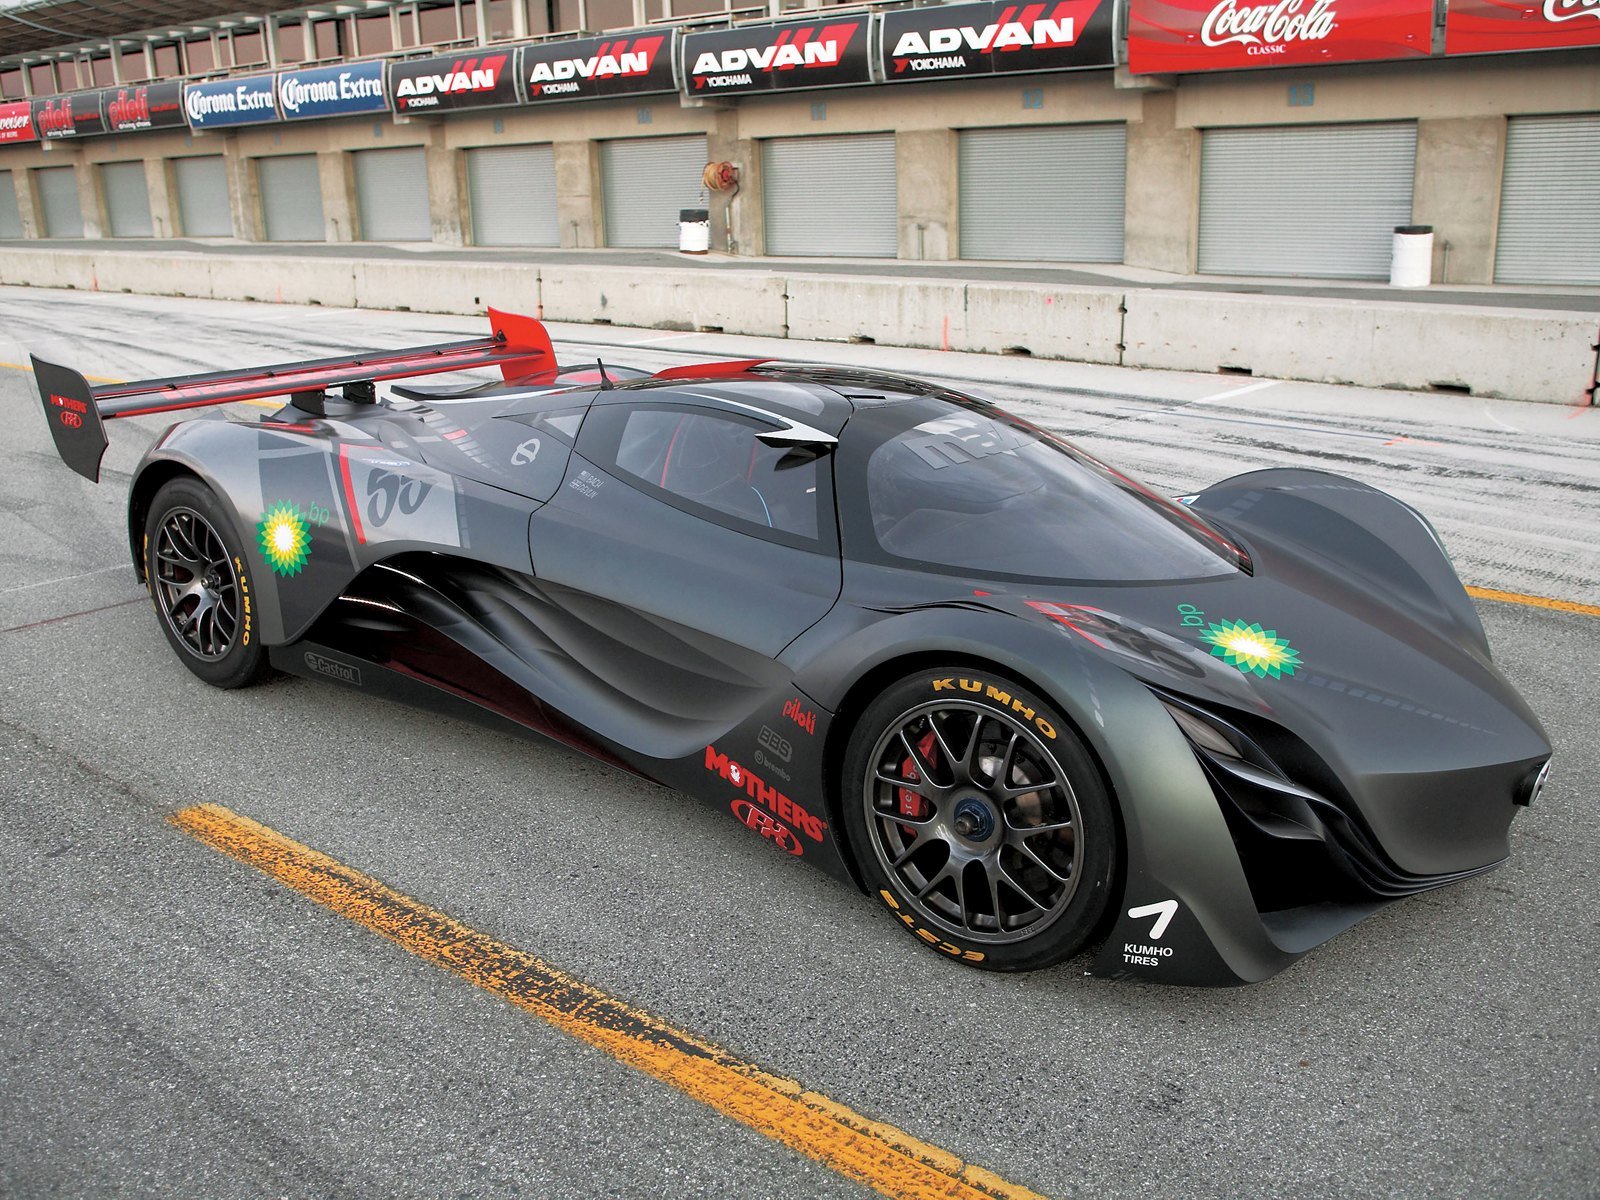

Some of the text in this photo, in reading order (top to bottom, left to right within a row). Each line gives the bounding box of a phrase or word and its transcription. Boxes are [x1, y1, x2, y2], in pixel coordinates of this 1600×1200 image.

[893, 17, 1074, 56] ADVAN
[1247, 45, 1286, 55] CLASSIC
[530, 51, 647, 83] ADVAN
[692, 40, 837, 74] ADVAN
[909, 56, 965, 71] YOKOHAMA
[282, 73, 382, 112] Corona Extra
[397, 69, 494, 97] ADVAN
[541, 82, 580, 95] YOKOHAMA
[706, 74, 752, 88] YOKOHAMA
[188, 86, 273, 122] Corona Extra
[407, 96, 439, 108] YOKOHAMA
[50, 394, 87, 414] MOTHERS
[308, 501, 329, 527] bp
[233, 555, 251, 646] KUMHO
[1177, 603, 1204, 627] bp
[317, 659, 354, 681] Castrol
[782, 698, 817, 736] piloti
[932, 678, 1057, 739] KUMHO
[758, 728, 791, 760] BBS
[763, 757, 791, 782] brembo
[705, 745, 826, 842] MOTHERS
[880, 889, 986, 962] ECSTA
[1123, 953, 1159, 967] TIRES
[1124, 943, 1173, 957] KUMHO
